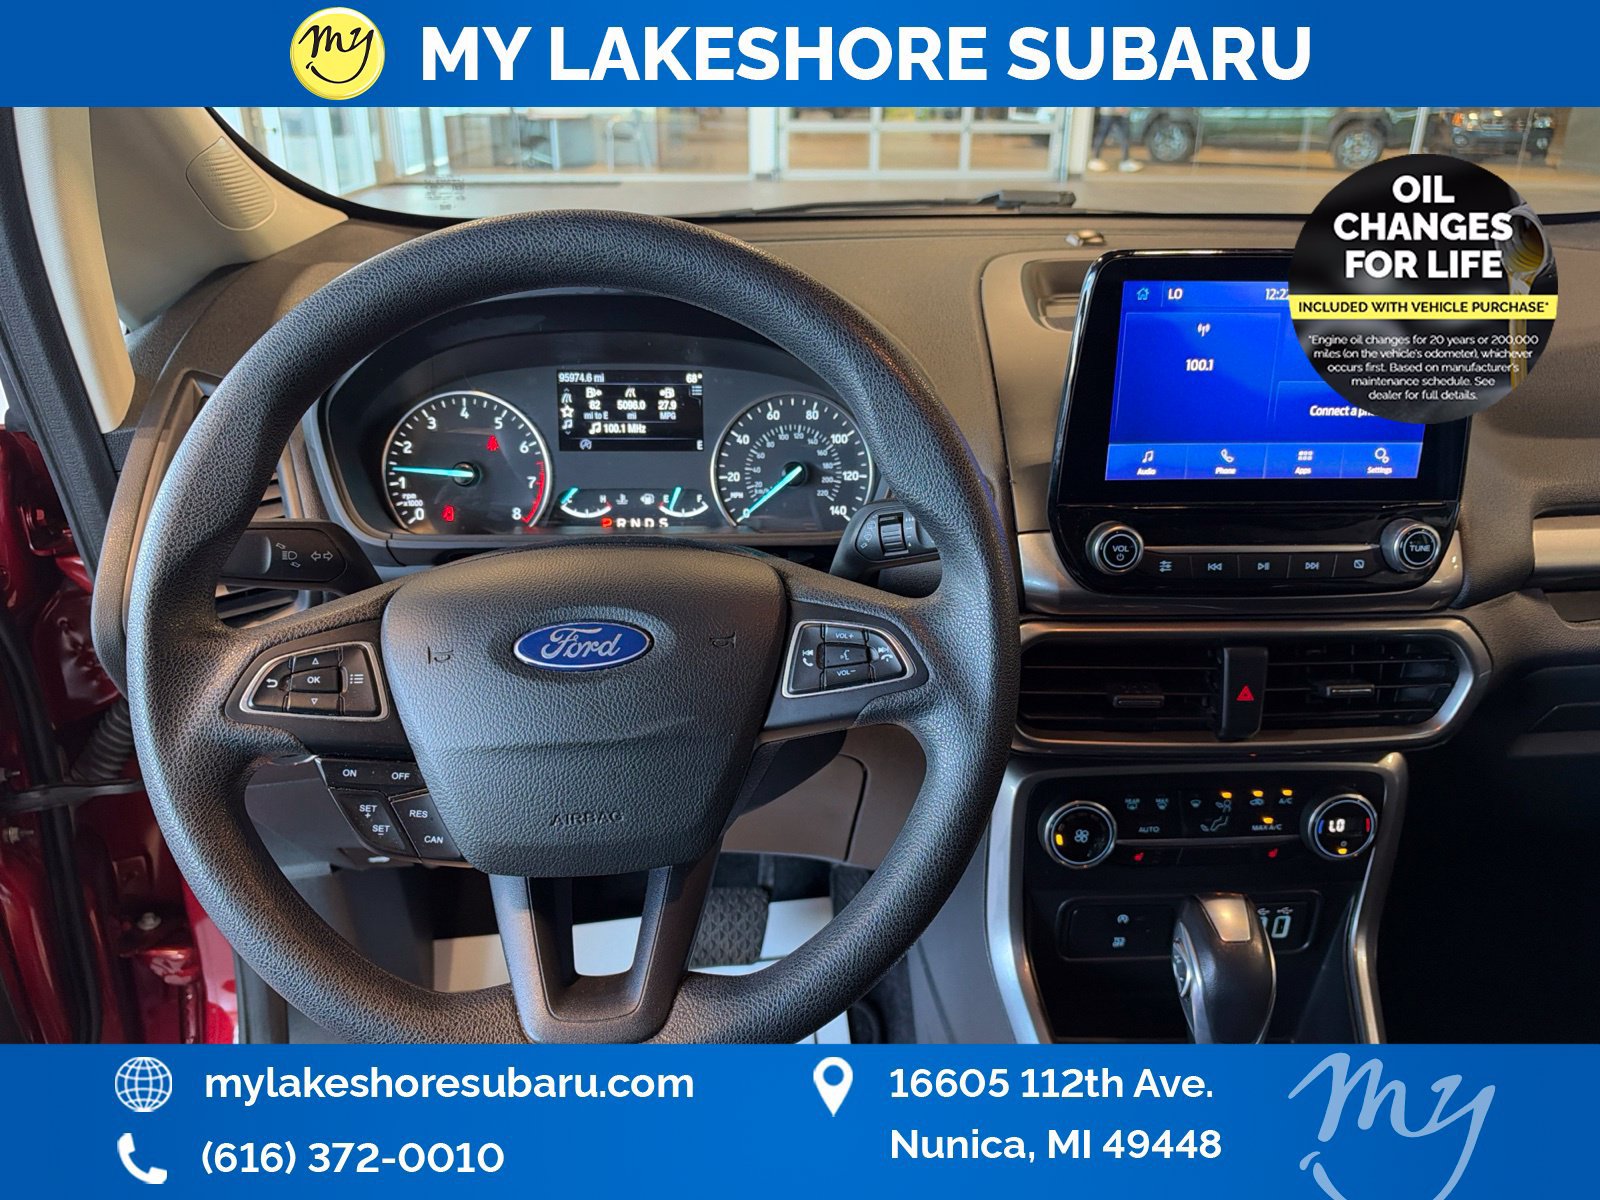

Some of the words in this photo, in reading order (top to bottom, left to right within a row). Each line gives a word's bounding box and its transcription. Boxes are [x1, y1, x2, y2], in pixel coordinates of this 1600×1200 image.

[1168, 288, 1183, 300] LO
[1186, 359, 1214, 371] 100.1
[559, 373, 592, 382] 95974.6
[594, 373, 604, 382] mi
[658, 400, 677, 410] 27.9
[460, 407, 469, 419] 4
[584, 411, 593, 420] mi
[595, 411, 602, 420] to
[603, 411, 609, 420] E
[627, 411, 637, 420] mi
[659, 411, 676, 420] MPG
[767, 410, 780, 420] 60
[806, 410, 819, 420] 80
[1310, 405, 1350, 416] Connect
[1350, 407, 1357, 416] a
[427, 417, 437, 430] 3
[494, 417, 504, 430] 5
[603, 424, 626, 434] 100.1
[627, 424, 646, 434] MHz
[736, 434, 750, 445] 40
[830, 434, 848, 444] 100
[402, 441, 412, 454] 2
[519, 441, 529, 454] 6
[696, 440, 703, 450] E
[842, 471, 859, 481] 120
[1137, 468, 1156, 476] Audio
[1215, 467, 1236, 475] Phone
[1295, 467, 1311, 476] Apps
[1367, 466, 1392, 476] Settings
[727, 472, 741, 482] 20
[399, 476, 406, 489] 1
[527, 477, 536, 489] 7
[600, 495, 607, 503] H
[663, 494, 669, 503] E
[697, 494, 702, 503] F
[414, 507, 424, 520] 0
[512, 508, 522, 520] 8
[743, 508, 750, 518] 0
[829, 506, 847, 516] 140
[616, 518, 627, 528] R
[630, 518, 640, 528] N
[644, 518, 655, 528] D
[659, 518, 669, 528] S
[541, 627, 622, 659] Ford
[307, 676, 321, 684] OK
[343, 769, 357, 777] ON
[391, 772, 410, 781] OFF
[359, 804, 377, 813] SET
[409, 810, 428, 818] RES
[550, 812, 624, 826] AIRBAG
[372, 825, 390, 833] SET
[1328, 818, 1346, 833] LO
[424, 836, 443, 844] CAN
